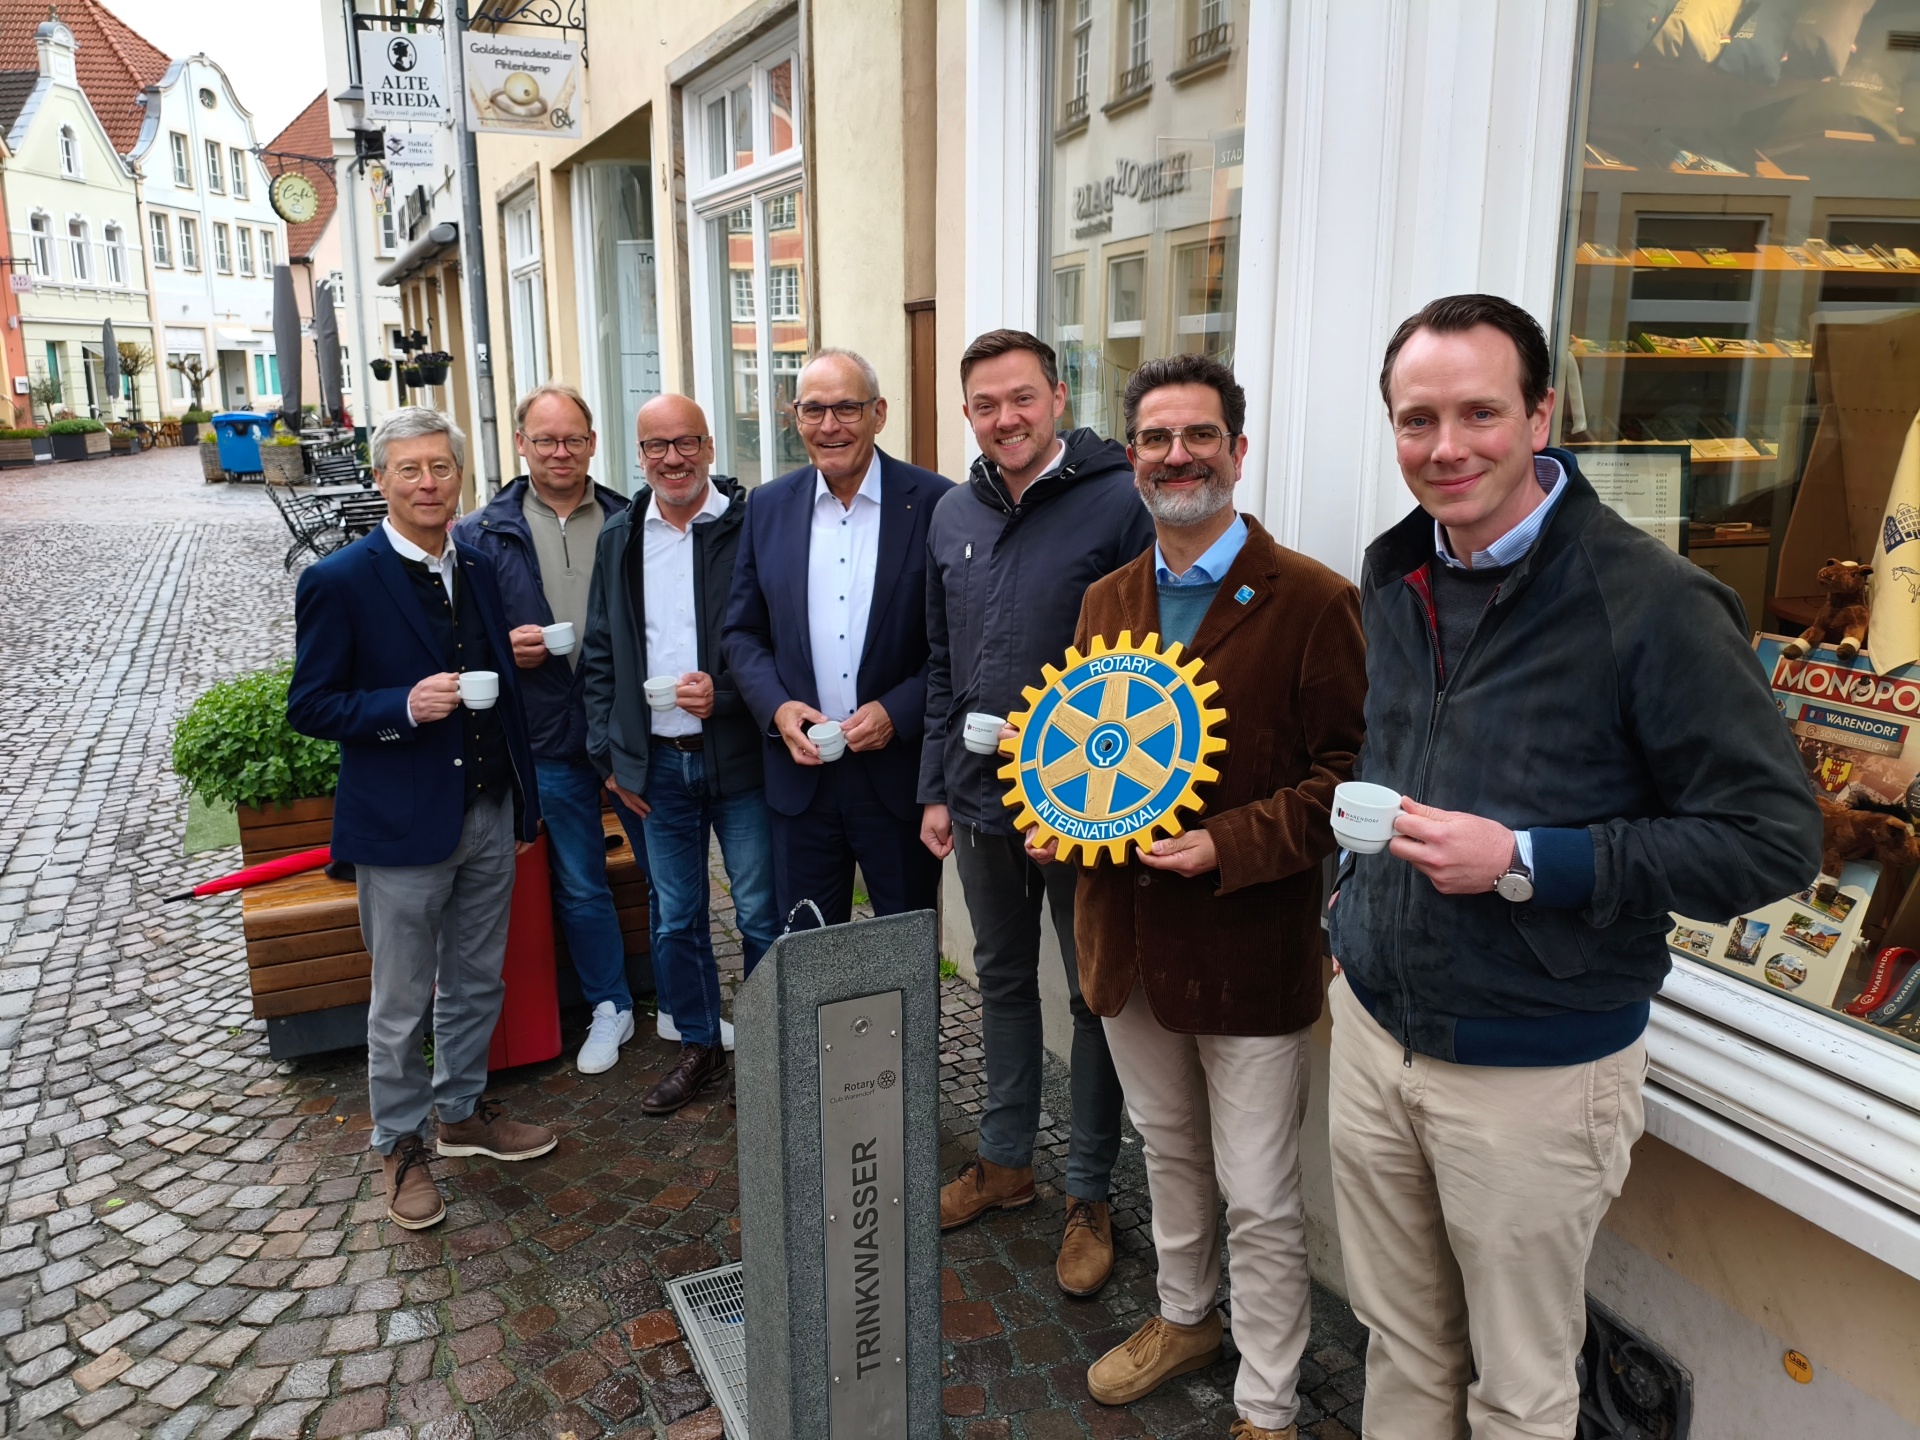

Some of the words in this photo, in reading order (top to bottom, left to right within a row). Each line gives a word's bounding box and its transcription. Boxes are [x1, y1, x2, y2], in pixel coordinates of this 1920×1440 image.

[470, 43, 573, 61] Goldschmiedeatelier
[495, 59, 551, 75] Ahlenkamp
[381, 75, 430, 91] ALTE
[370, 91, 441, 108] FRIEDA
[1089, 656, 1157, 676] ROTARY
[1777, 662, 1920, 715] MONOPO
[1826, 712, 1899, 738] WARENDORF
[1036, 799, 1162, 838] INTERNATIONAL
[1345, 812, 1379, 824] WARENDORF
[844, 1079, 876, 1092] Rotary
[829, 1096, 844, 1104] Club
[844, 1089, 876, 1101] Warendorf
[852, 1137, 881, 1380] TRINKWASSER
[1788, 1351, 1808, 1370] Gas
